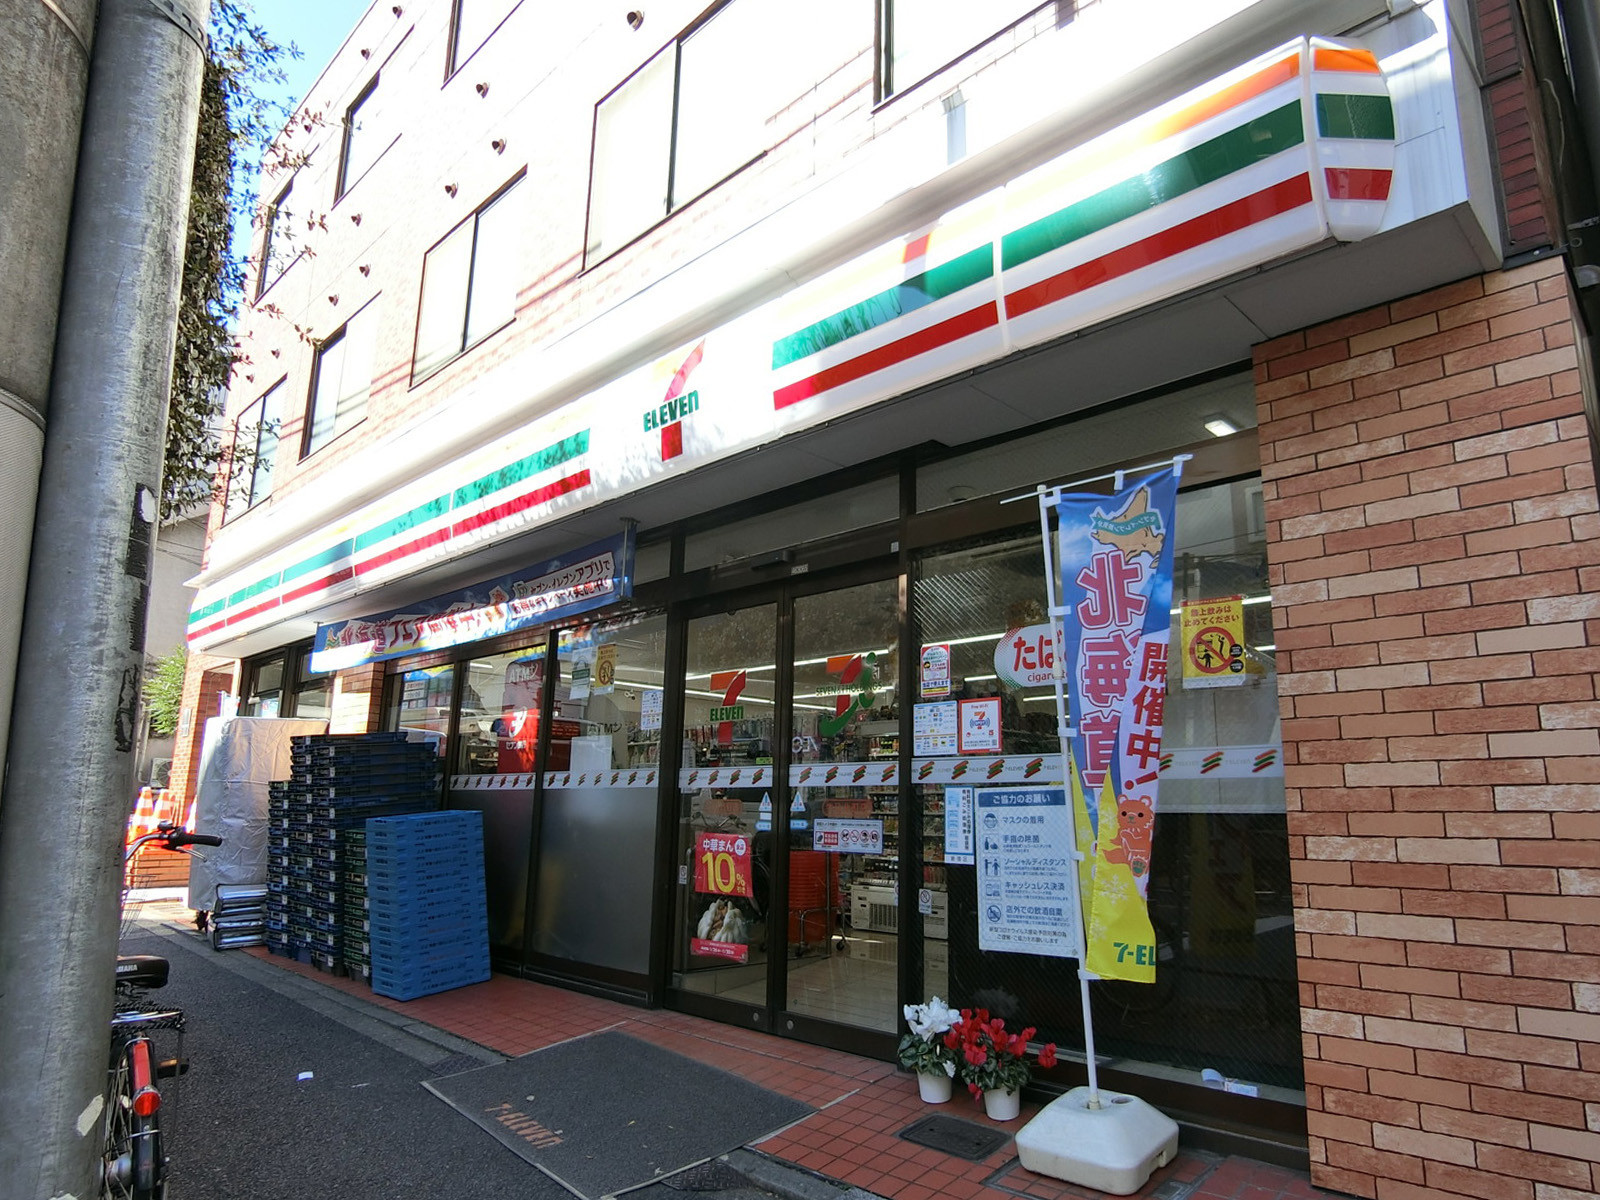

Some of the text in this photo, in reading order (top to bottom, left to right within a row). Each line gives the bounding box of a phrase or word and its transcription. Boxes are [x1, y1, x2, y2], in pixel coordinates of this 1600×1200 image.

[992, 792, 1051, 805] ご協力のお願い
[1002, 815, 1045, 825] マスクの着用
[702, 838, 734, 853] 中華まん
[1004, 858, 1067, 867] ソーシャルディスタンス
[1005, 881, 1065, 891] キャッシュレス決済
[116, 964, 137, 973] AMAHA
